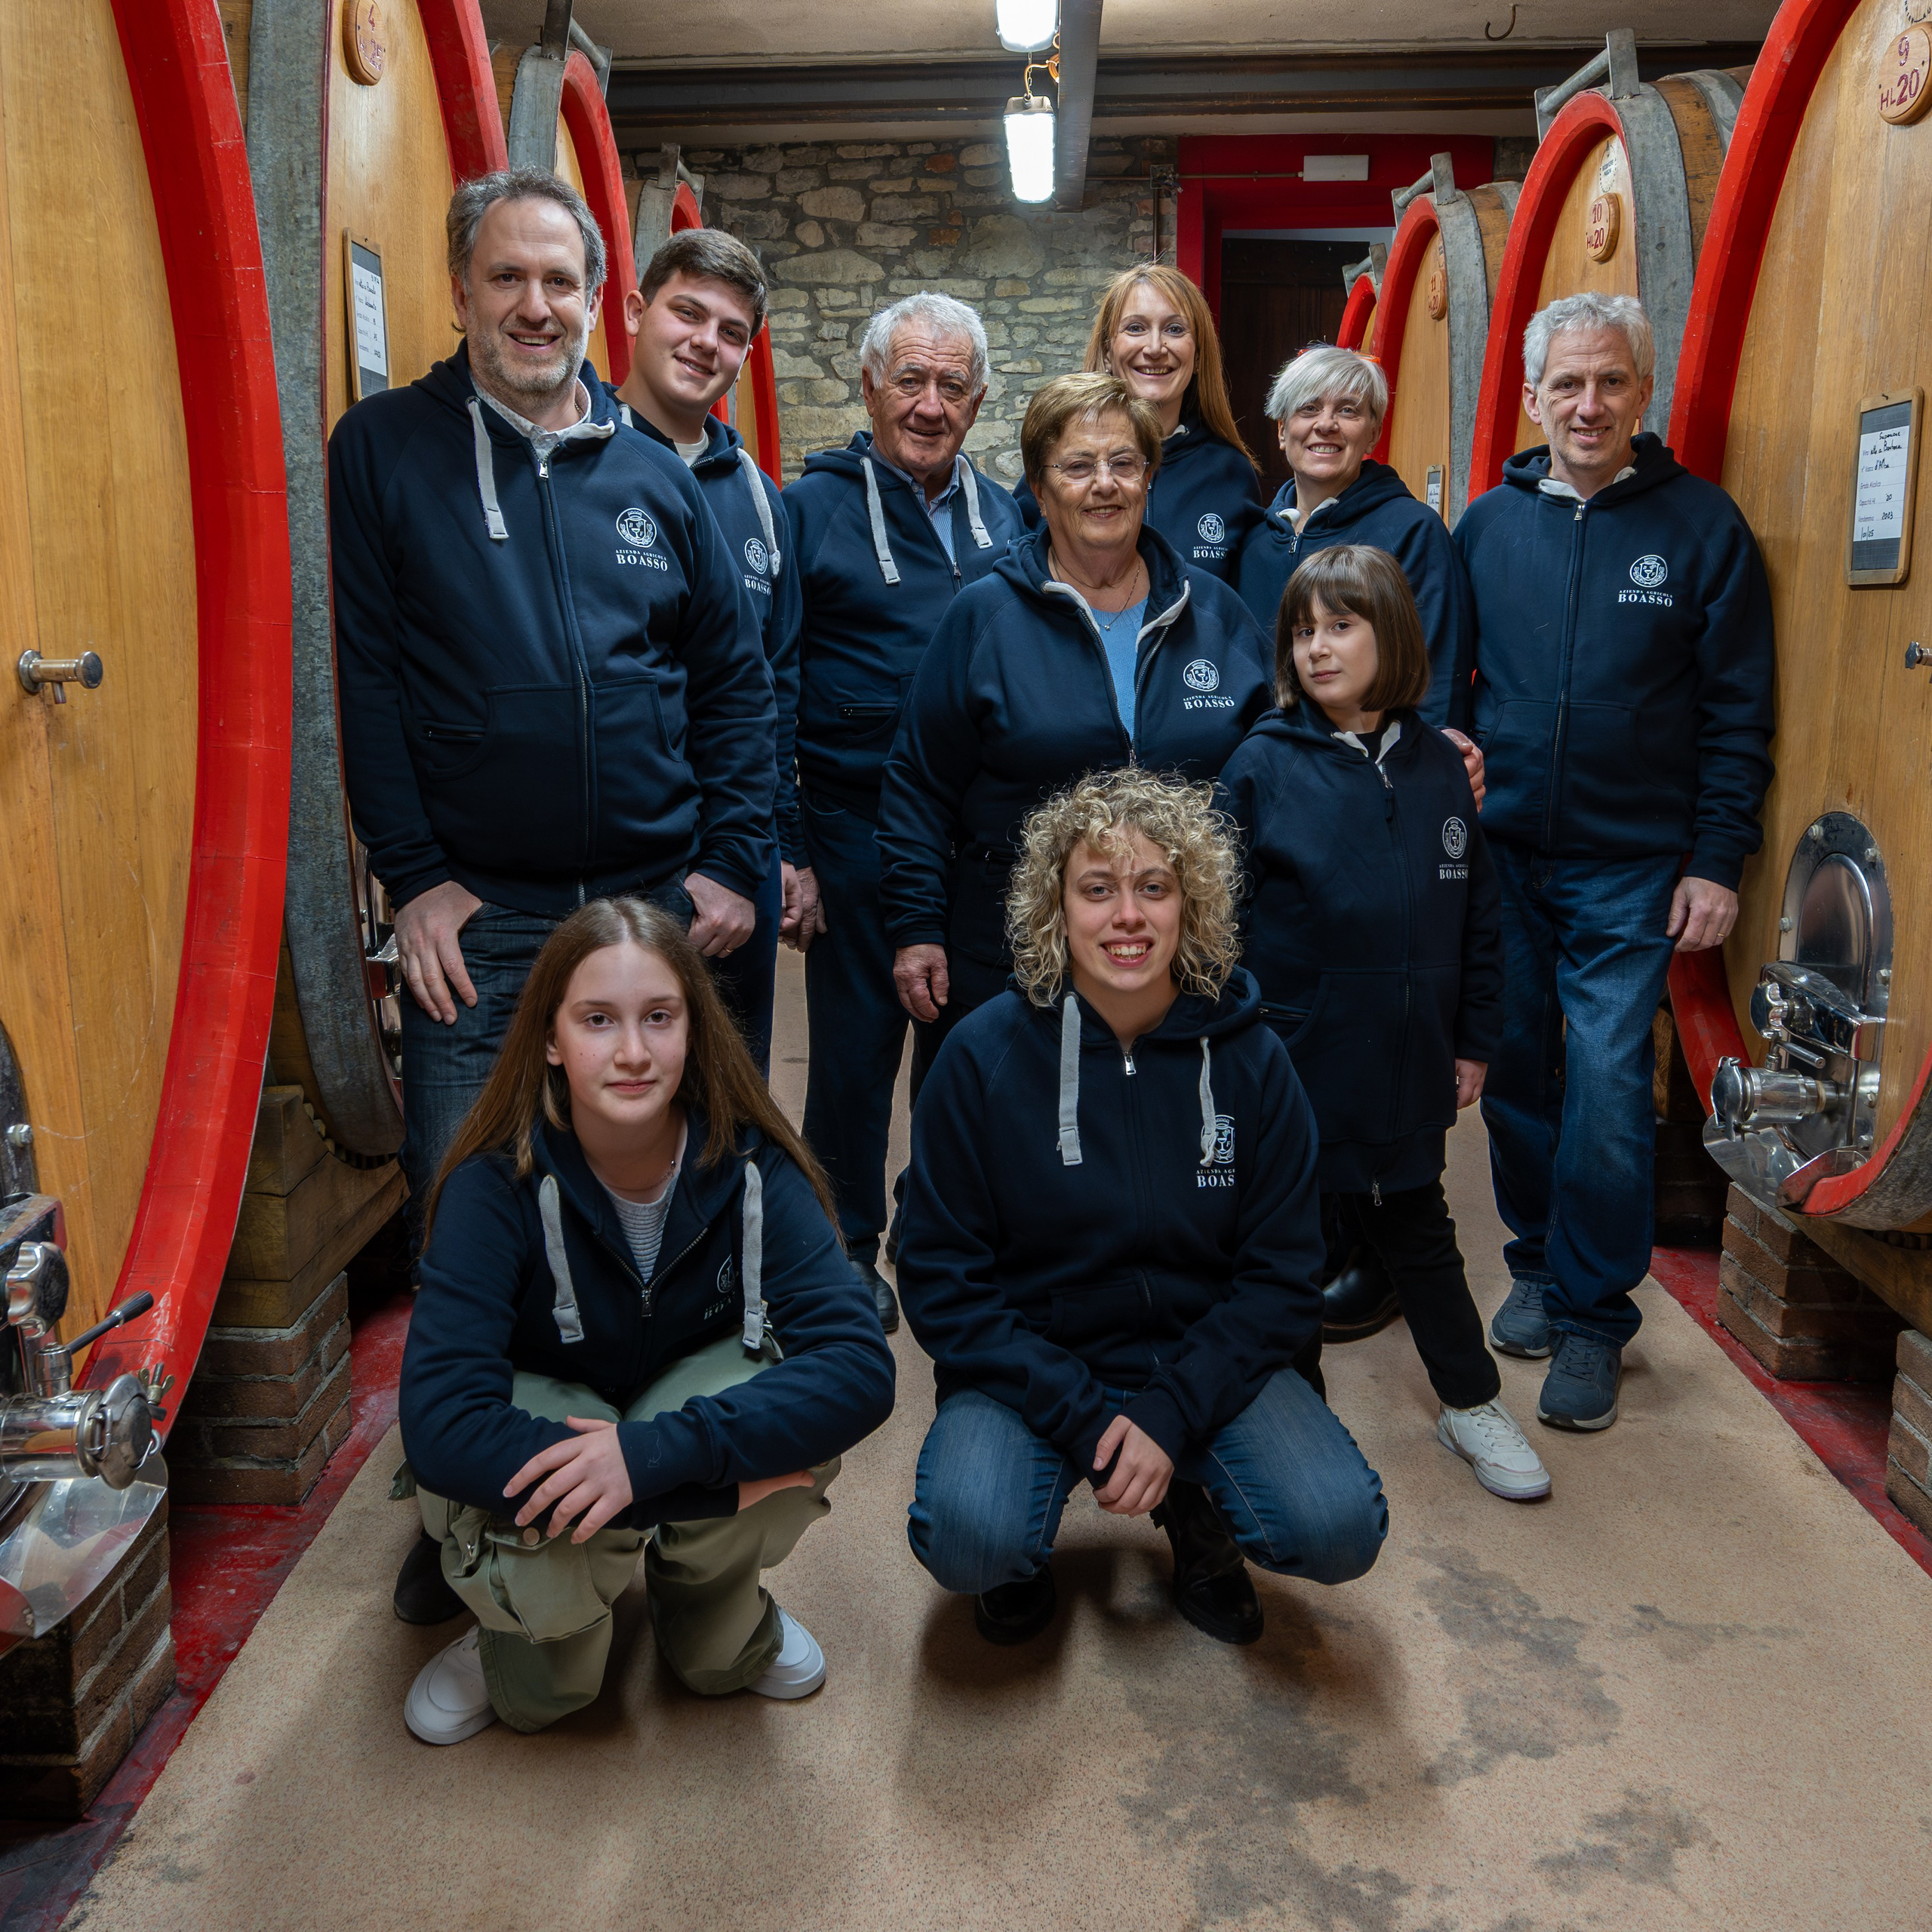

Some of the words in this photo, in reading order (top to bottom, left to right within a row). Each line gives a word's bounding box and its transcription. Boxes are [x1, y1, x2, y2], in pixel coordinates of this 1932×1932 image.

[368, 5, 375, 32] 4
[1898, 35, 1909, 66] 9
[1592, 202, 1602, 224] 10
[643, 552, 666, 561] AGRICOLA
[1193, 549, 1228, 559] BOASS
[616, 554, 668, 571] BOASSO
[744, 578, 771, 596] BOASSO
[1646, 590, 1673, 598] AGRICOLA
[1618, 593, 1673, 608] BOASSO
[1183, 699, 1235, 709] BOASSO
[1439, 869, 1469, 880] BOASSO
[1196, 1174, 1235, 1188] BOAS
